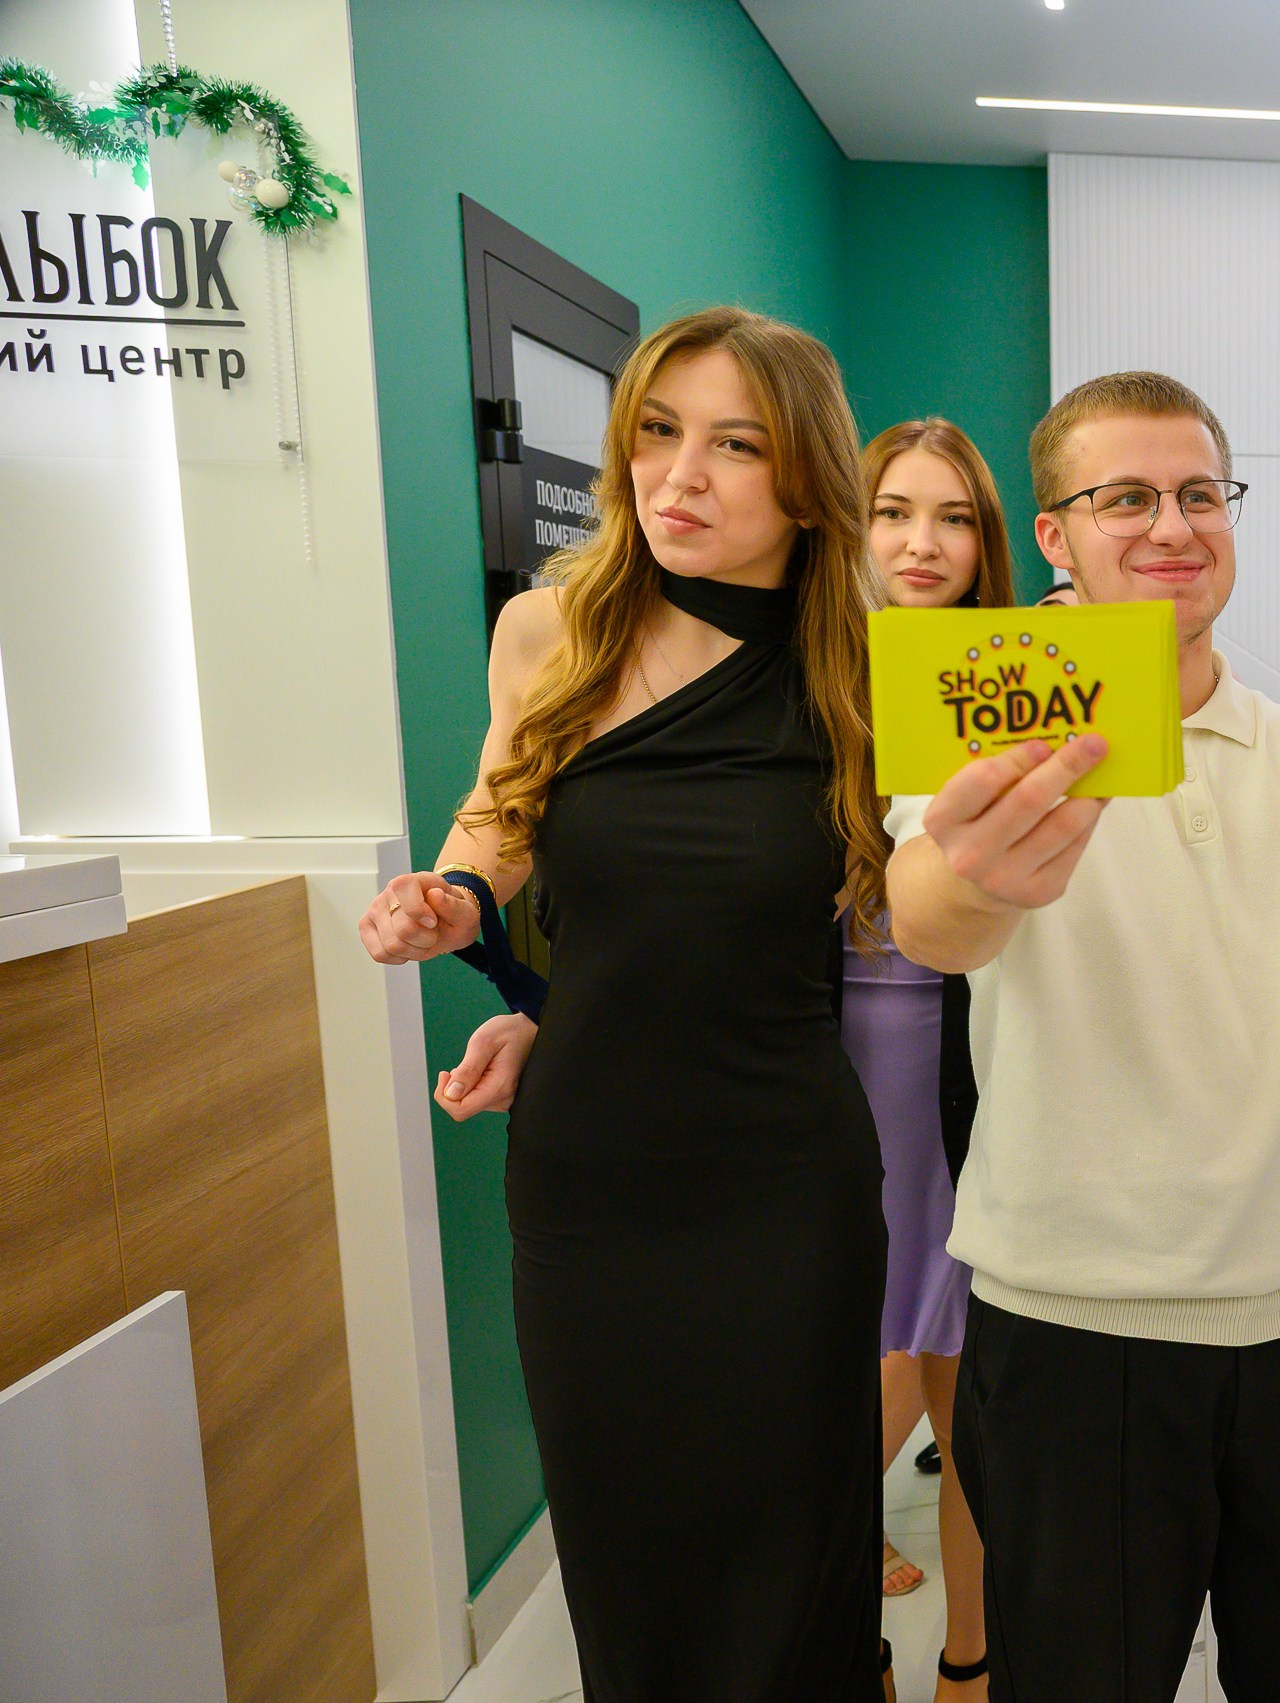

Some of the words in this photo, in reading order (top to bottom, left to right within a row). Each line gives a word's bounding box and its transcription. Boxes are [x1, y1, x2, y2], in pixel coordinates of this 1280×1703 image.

[81, 344, 246, 390] центр
[536, 480, 600, 516] ПОДСОБНО
[939, 662, 1027, 700] SHOW
